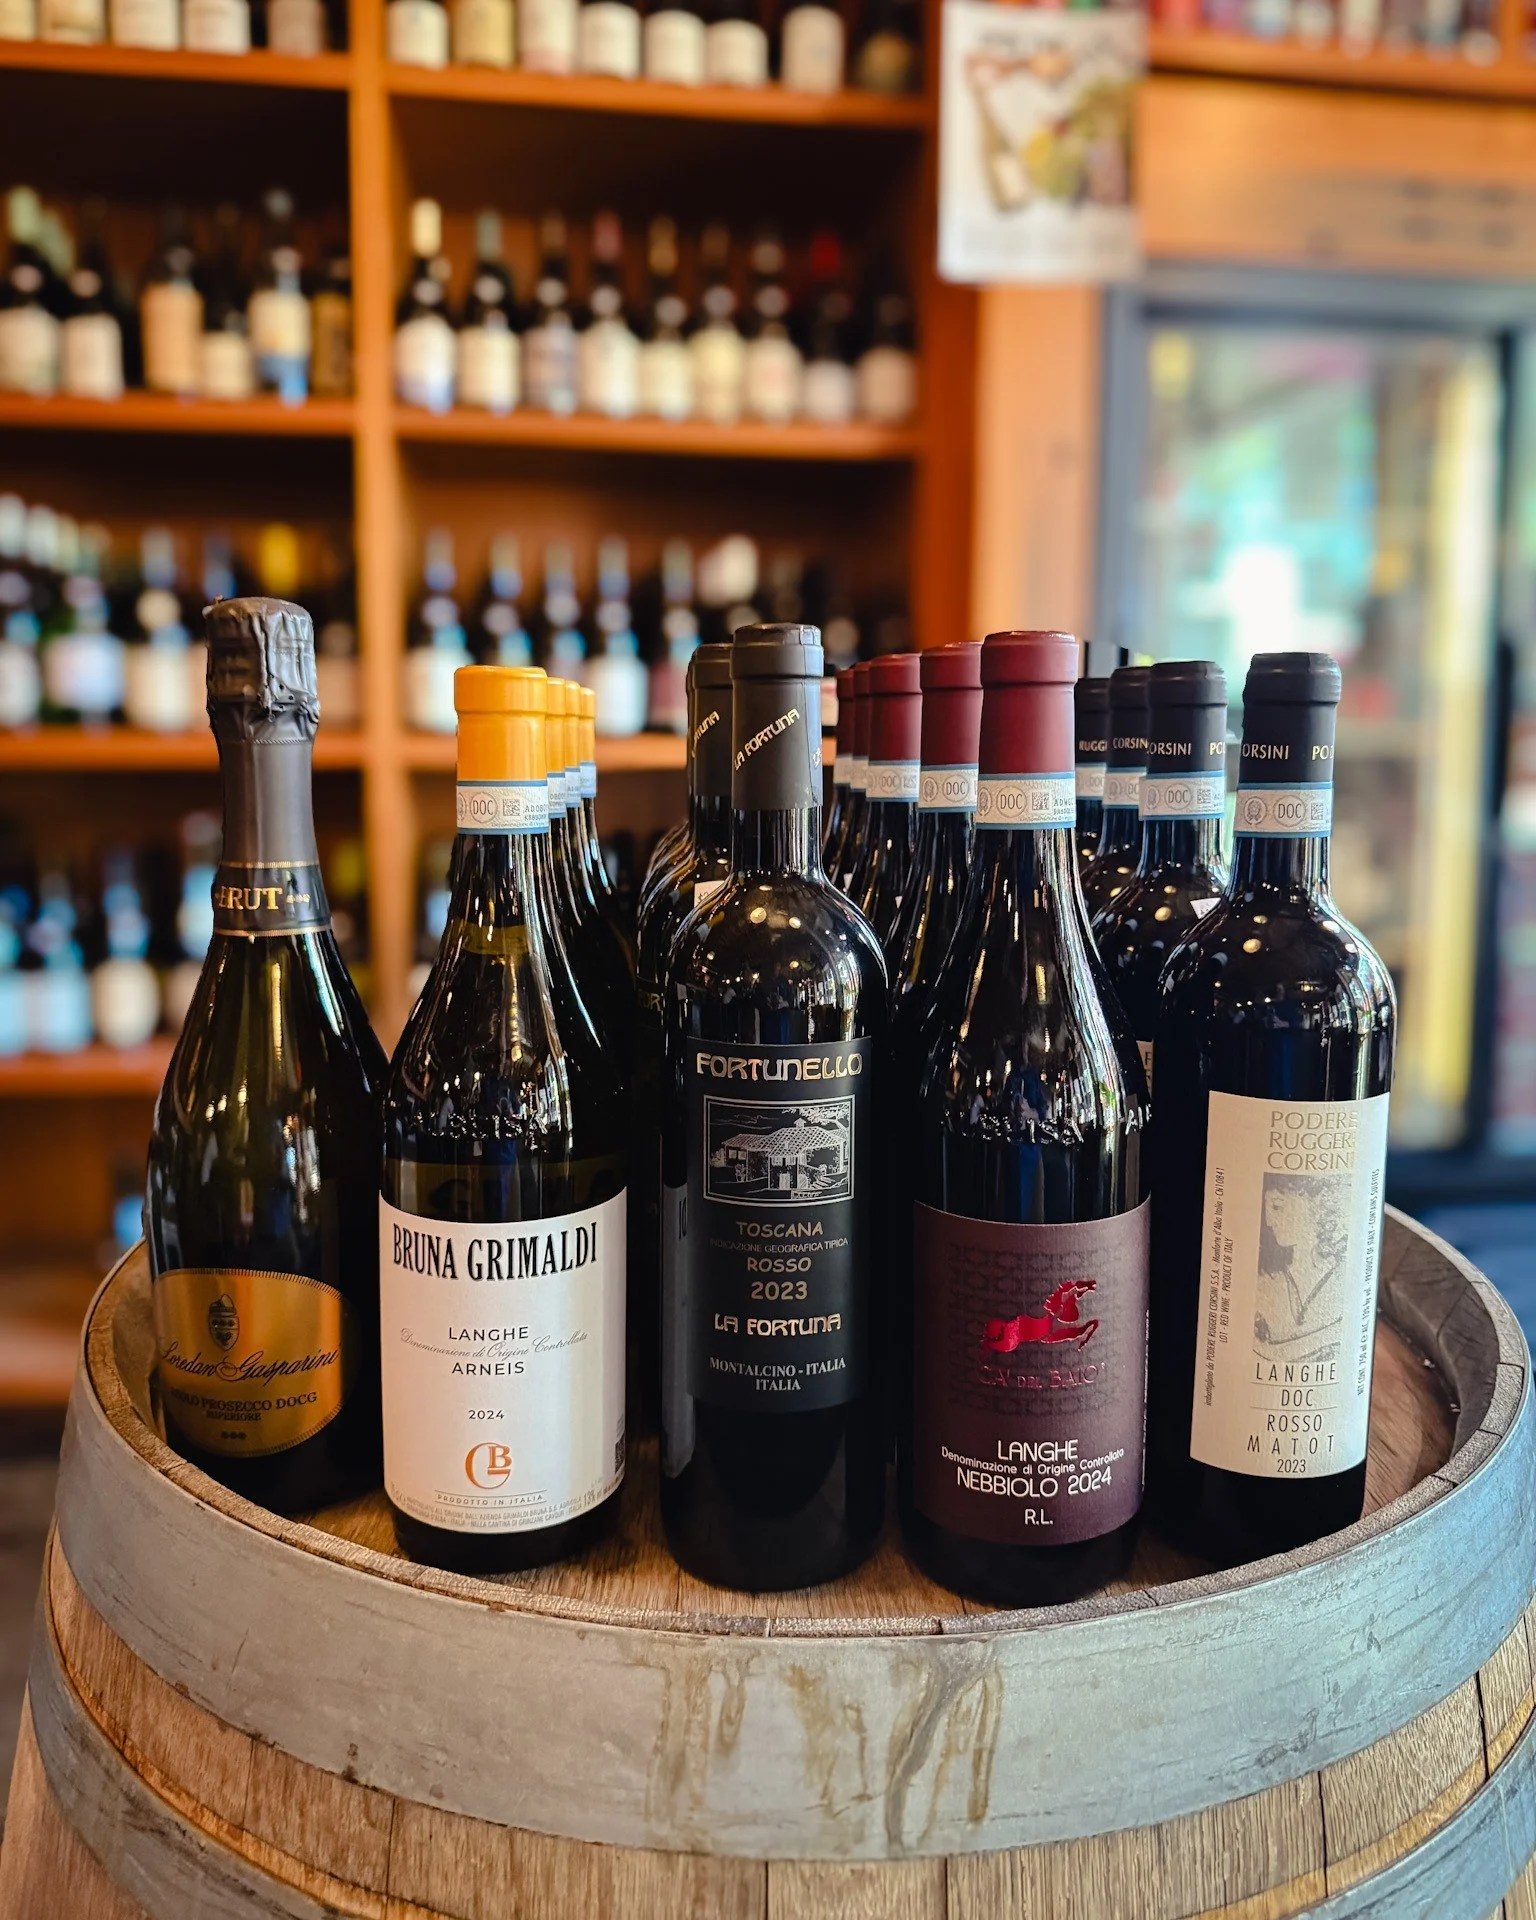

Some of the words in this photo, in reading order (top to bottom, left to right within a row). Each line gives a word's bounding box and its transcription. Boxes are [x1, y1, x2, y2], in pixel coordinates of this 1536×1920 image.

[734, 751, 745, 771] LA
[744, 708, 801, 757] FORTUNA
[1112, 737, 1148, 750] CORSIN
[1147, 742, 1192, 756] ORSINI
[1242, 743, 1289, 760] ORSINI
[881, 775, 897, 788] DOC
[945, 781, 966, 796] DOC
[999, 793, 1021, 811] DOC
[1168, 789, 1189, 804] DOC
[473, 799, 494, 816] DOC
[1278, 803, 1302, 819] DOC
[219, 885, 283, 911] BRUT
[696, 1052, 863, 1082] FORTUNELLO
[1270, 1111, 1359, 1130] PODERE
[1214, 1201, 1223, 1216] Italia
[1368, 1196, 1378, 1225] CONTAINS
[736, 1221, 824, 1238] TOSCANA
[1213, 1216, 1223, 1235] d'Alba
[393, 1223, 459, 1280] BRUNA
[467, 1221, 597, 1282] GRIMALDI
[764, 1240, 824, 1254] GEOGRAFICA
[824, 1236, 849, 1251] TIPICA
[1211, 1237, 1221, 1263] Monforte
[1224, 1237, 1234, 1254] ITALY
[747, 1256, 812, 1274] ROSSO
[1222, 1264, 1232, 1293] PRODUCT
[751, 1280, 808, 1301] 2023
[1208, 1286, 1218, 1311] CORSINI
[1221, 1297, 1230, 1313] WINE
[714, 1312, 739, 1334] LA
[746, 1312, 842, 1338] FORTUNA
[1207, 1311, 1217, 1337] RUGGERI
[1220, 1314, 1229, 1327] RED
[448, 1326, 529, 1342] LANGHE
[1219, 1332, 1228, 1343] LOT
[400, 1327, 471, 1358] Denominazione
[472, 1346, 484, 1358] di
[486, 1341, 529, 1361] Origine
[532, 1329, 590, 1353] Controllata
[1206, 1337, 1216, 1362] PODERE
[160, 1341, 217, 1378] Loredan
[216, 1343, 341, 1387] Gasparini
[452, 1361, 525, 1377] ARNEIS
[709, 1355, 797, 1378] MONTALCINO
[805, 1357, 847, 1377] ITALIA
[1255, 1362, 1337, 1383] LANGHE
[755, 1378, 802, 1392] ITALIA
[201, 1397, 273, 1412] PROSECCO
[275, 1391, 317, 1409] DOCG
[1281, 1389, 1314, 1407] DOC
[468, 1409, 505, 1421] 2024
[1267, 1414, 1323, 1433] ROSSO
[997, 1439, 1079, 1463] LANGHE
[1247, 1434, 1335, 1455] MATOT
[941, 1445, 1018, 1475] Denominazione
[1022, 1463, 1033, 1475] di
[1038, 1462, 1076, 1477] Origine
[1079, 1447, 1124, 1470] Controllata
[1276, 1458, 1307, 1474] 2023
[957, 1466, 1059, 1499] NEBBIOLO
[1067, 1466, 1112, 1496] 2024
[437, 1494, 489, 1506] PRODOTTO
[510, 1494, 543, 1505] ITALIA
[1024, 1508, 1054, 1526] R.L.
